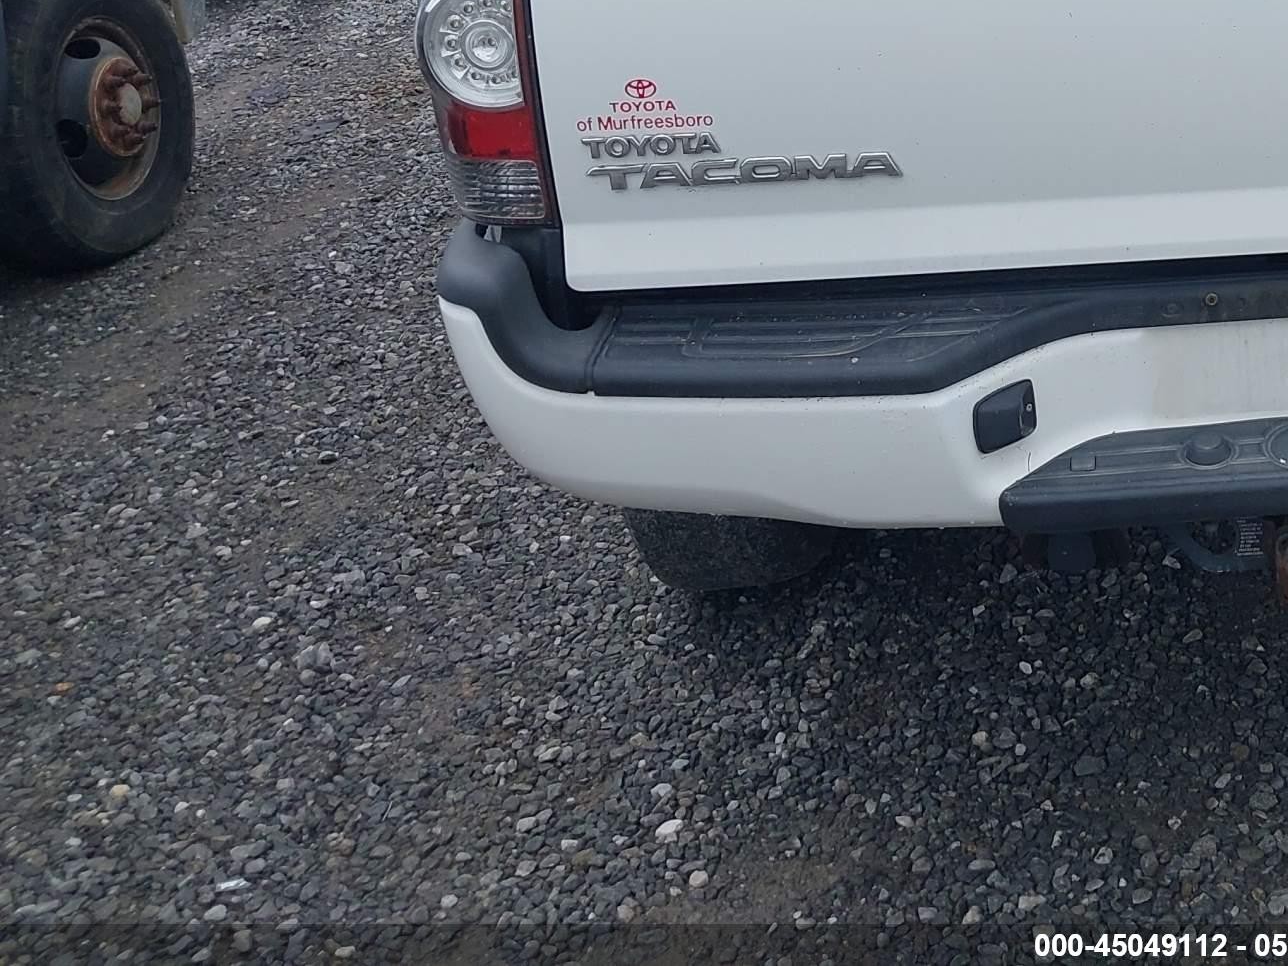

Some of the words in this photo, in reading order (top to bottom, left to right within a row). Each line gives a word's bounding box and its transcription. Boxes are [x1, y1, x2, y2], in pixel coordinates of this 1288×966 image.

[609, 100, 676, 113] TOYOTA
[577, 117, 593, 132] of
[598, 114, 713, 131] Murfreesboro
[581, 132, 721, 159] TOYOTA
[585, 151, 903, 190] TACOMA
